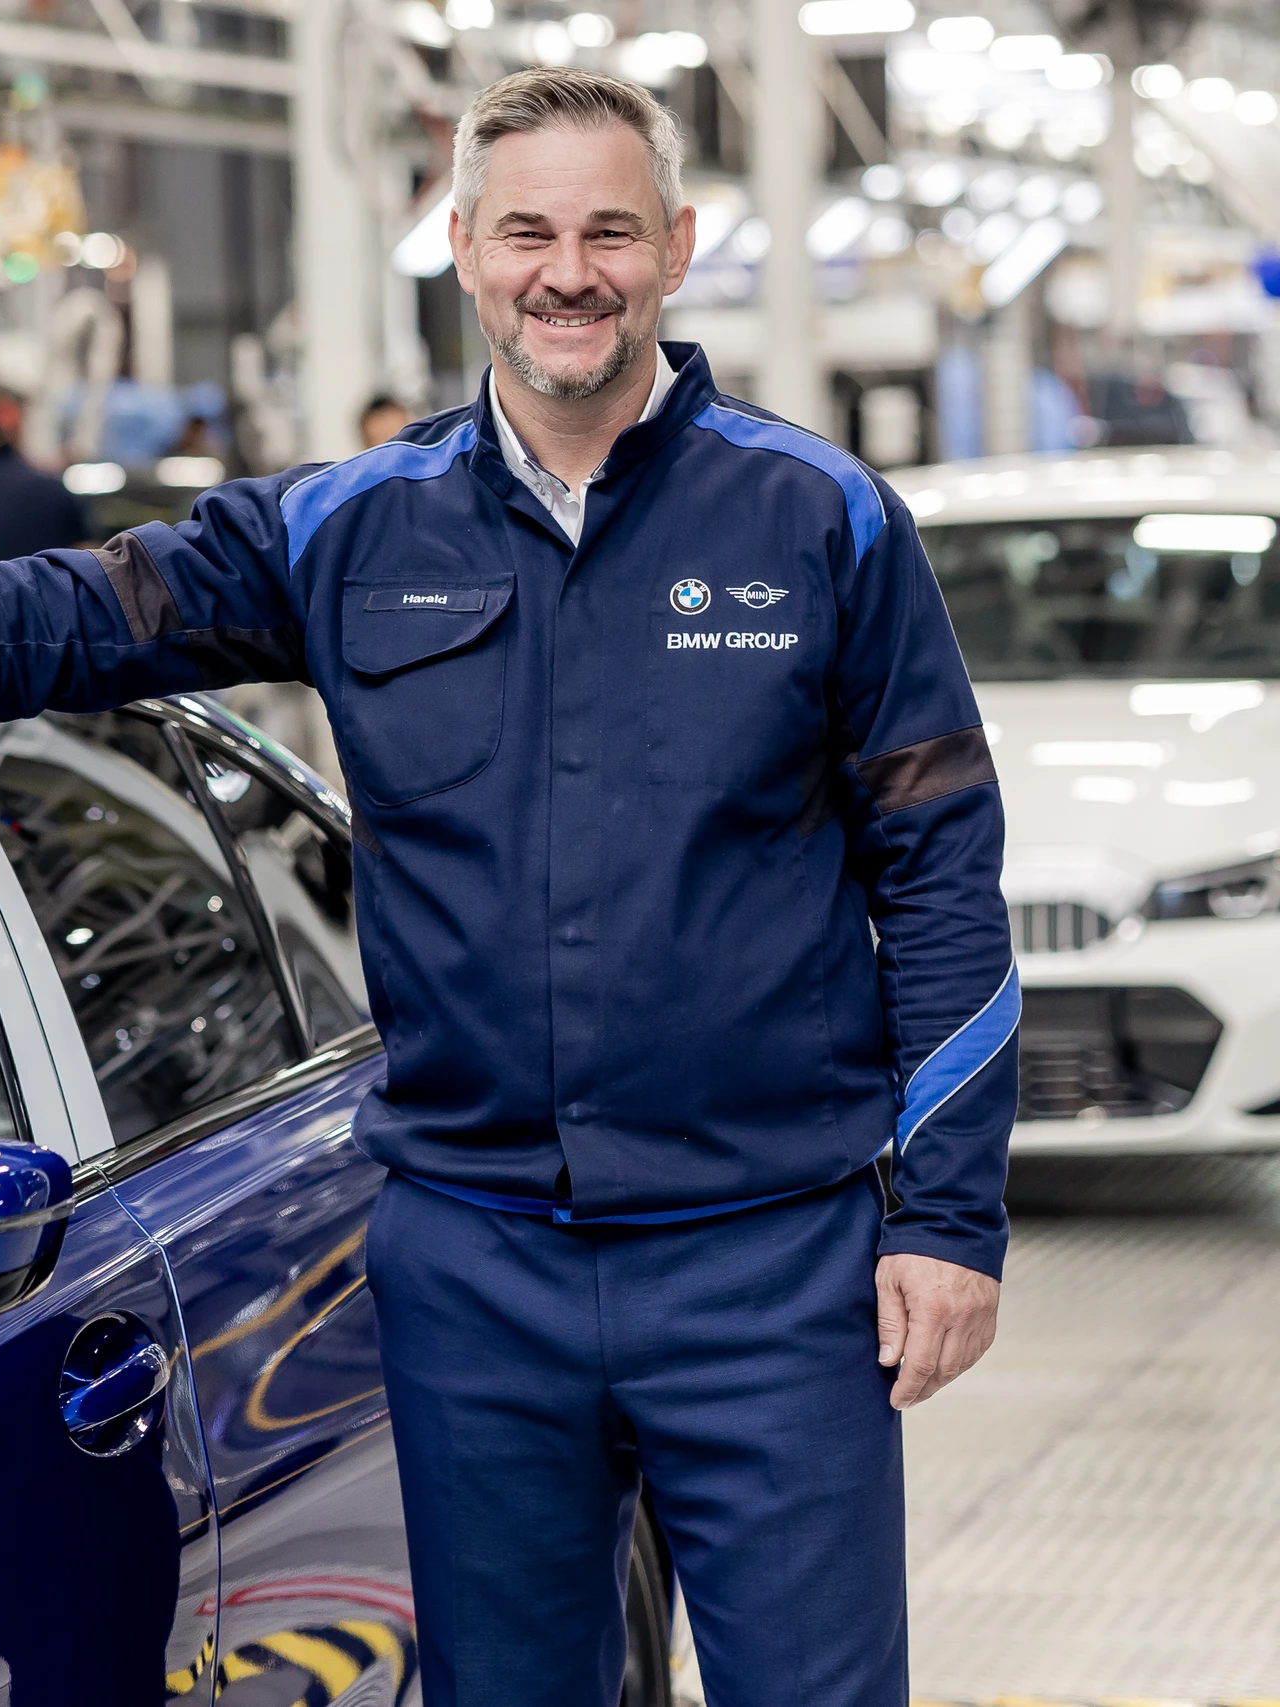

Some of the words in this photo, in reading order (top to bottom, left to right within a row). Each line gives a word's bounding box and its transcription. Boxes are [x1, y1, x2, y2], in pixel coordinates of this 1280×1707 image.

[402, 594, 448, 605] Harald
[747, 591, 768, 600] MINI
[667, 632, 722, 649] BMW
[725, 632, 799, 650] GROUP
